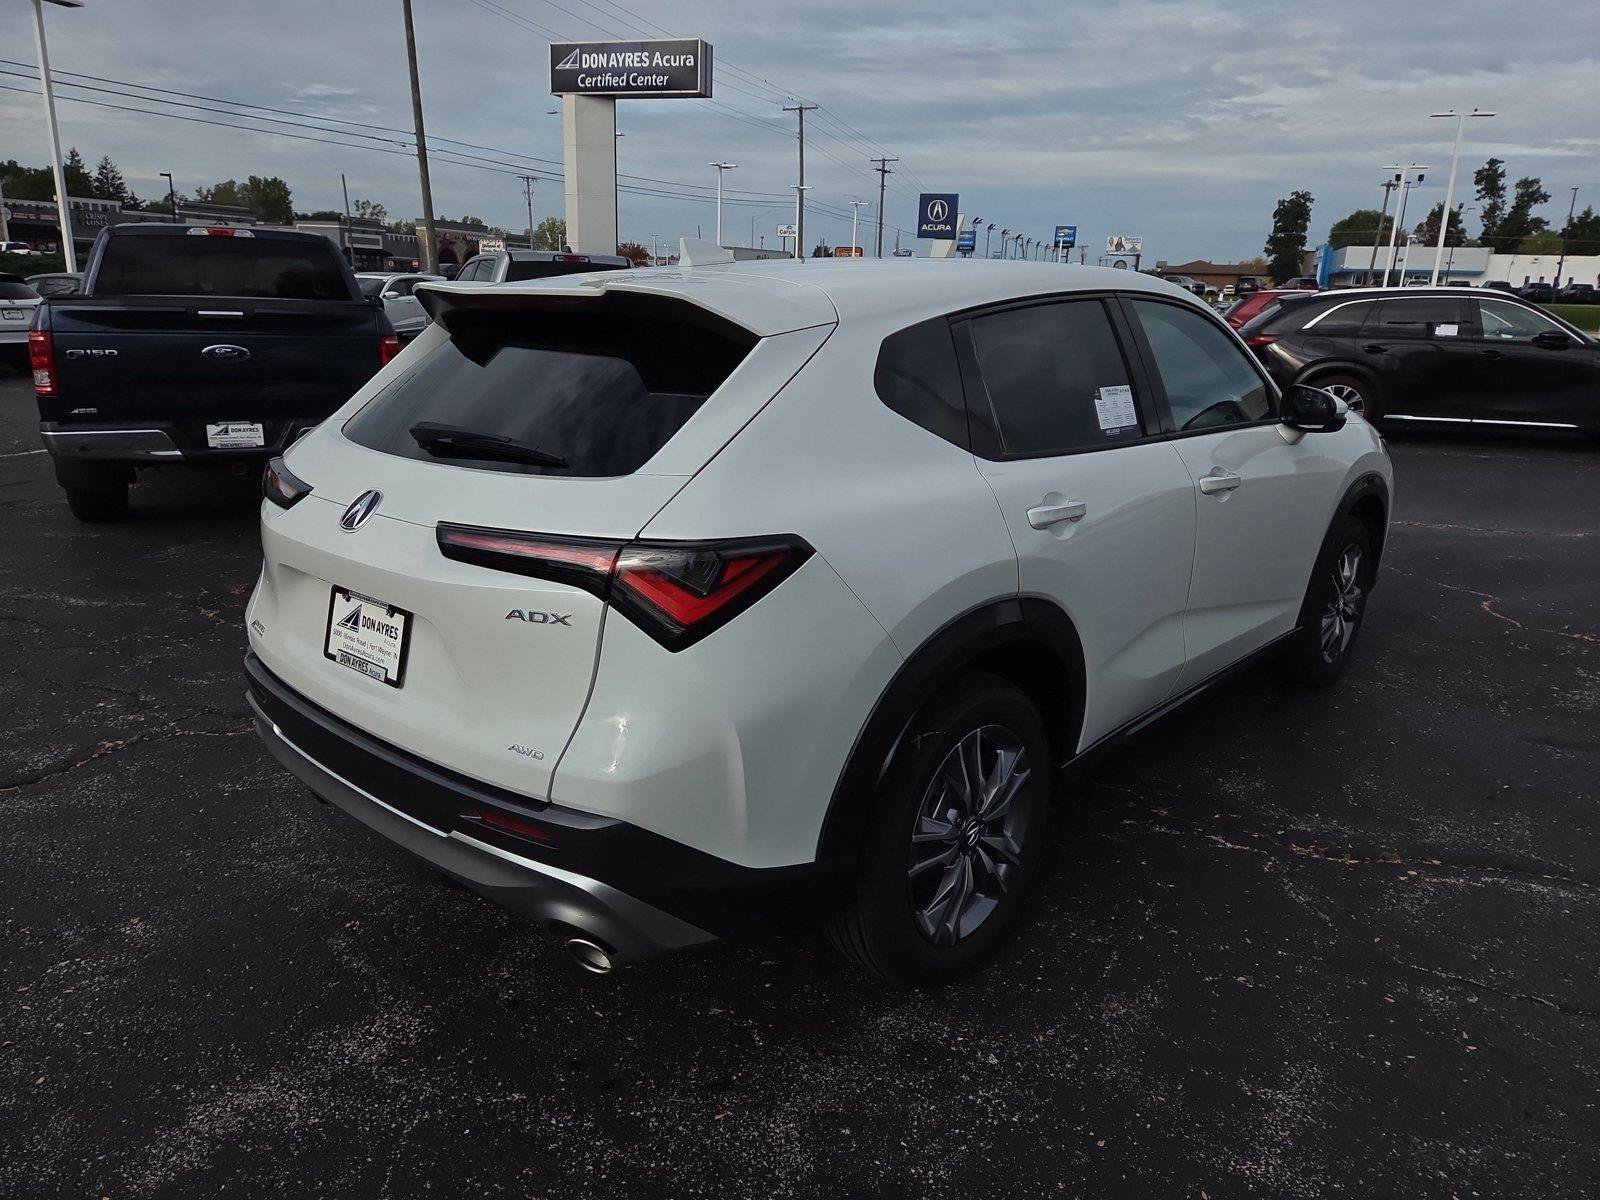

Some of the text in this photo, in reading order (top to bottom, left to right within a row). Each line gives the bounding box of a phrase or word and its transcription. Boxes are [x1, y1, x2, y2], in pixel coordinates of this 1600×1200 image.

[582, 51, 694, 69] DON AYRES Acura
[577, 72, 669, 87] Certified Center
[921, 223, 952, 231] ACURA
[504, 609, 573, 627] ADX
[361, 615, 399, 640] DON AYRES
[356, 638, 367, 647] Road
[340, 652, 352, 665] DON
[351, 656, 369, 673] AYRES
[508, 744, 544, 760] AWD
